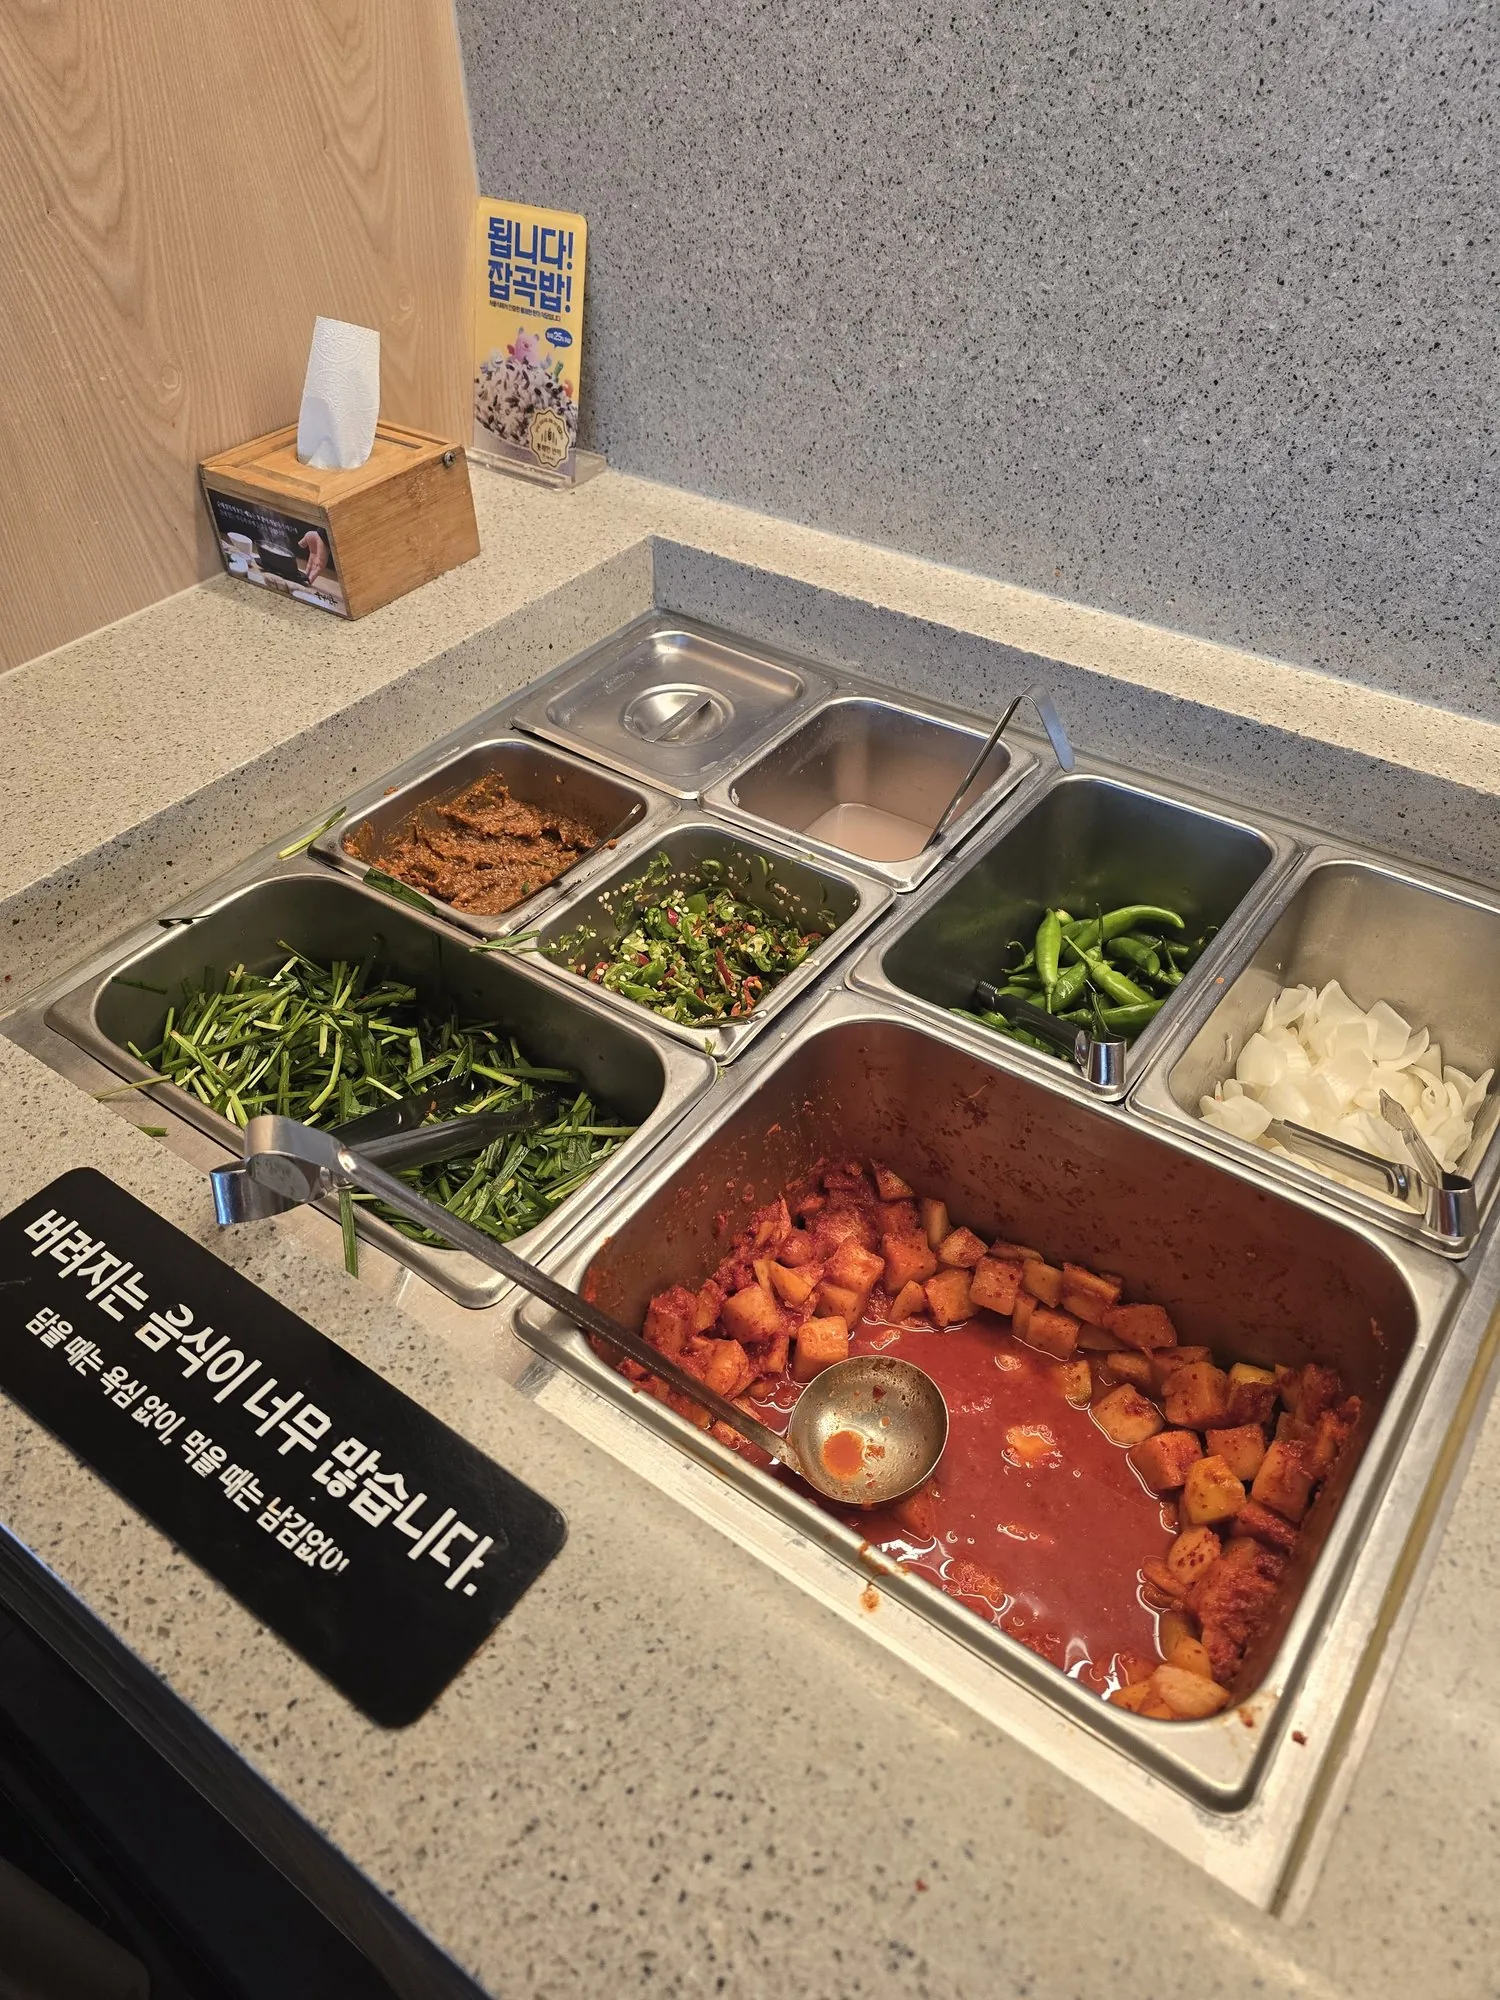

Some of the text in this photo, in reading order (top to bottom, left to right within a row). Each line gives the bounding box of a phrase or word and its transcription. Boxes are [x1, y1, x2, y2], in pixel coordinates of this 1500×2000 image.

[488, 216, 574, 271] 됩니다!
[488, 259, 572, 313] 잡곡밥!
[24, 1208, 494, 1596] 버려지는 음식이 너무 많습니다.
[25, 1307, 350, 1573] 담을 때는 욕심 없이, 먹을 때는 남김없이
